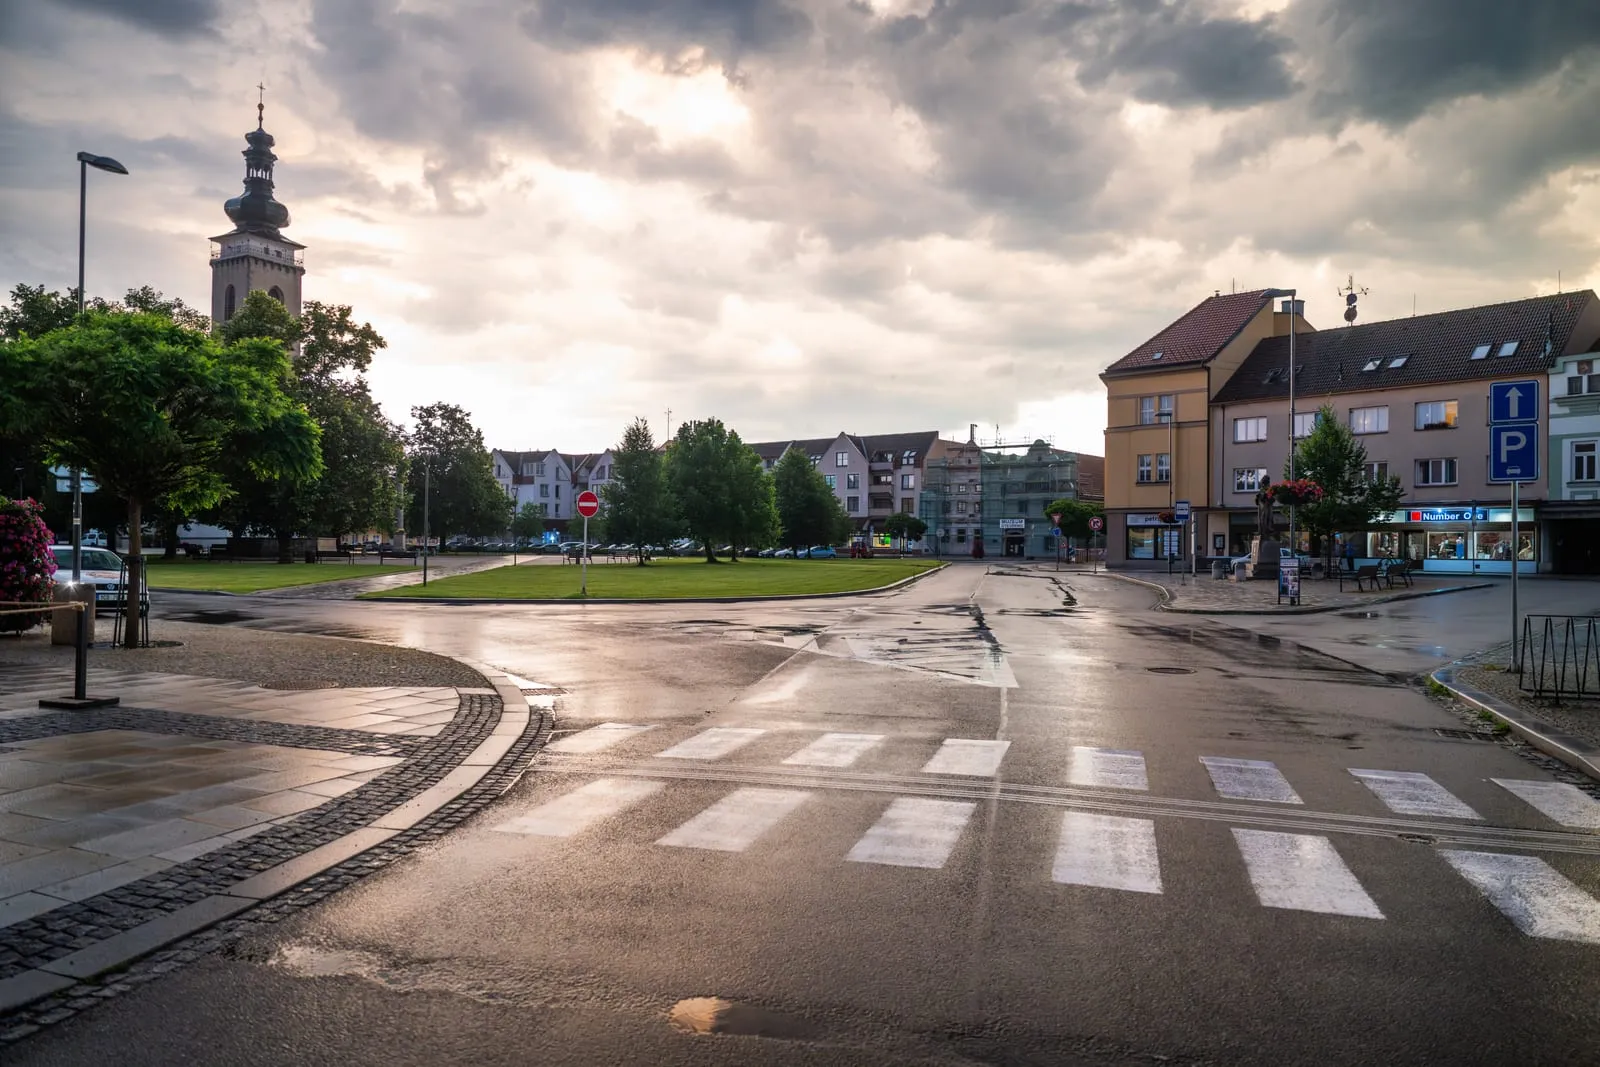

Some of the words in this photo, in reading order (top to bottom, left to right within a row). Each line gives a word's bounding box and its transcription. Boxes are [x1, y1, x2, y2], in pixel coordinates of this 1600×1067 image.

[1500, 431, 1527, 463] P
[1423, 512, 1459, 520] Number
[1463, 512, 1483, 520] Oe
